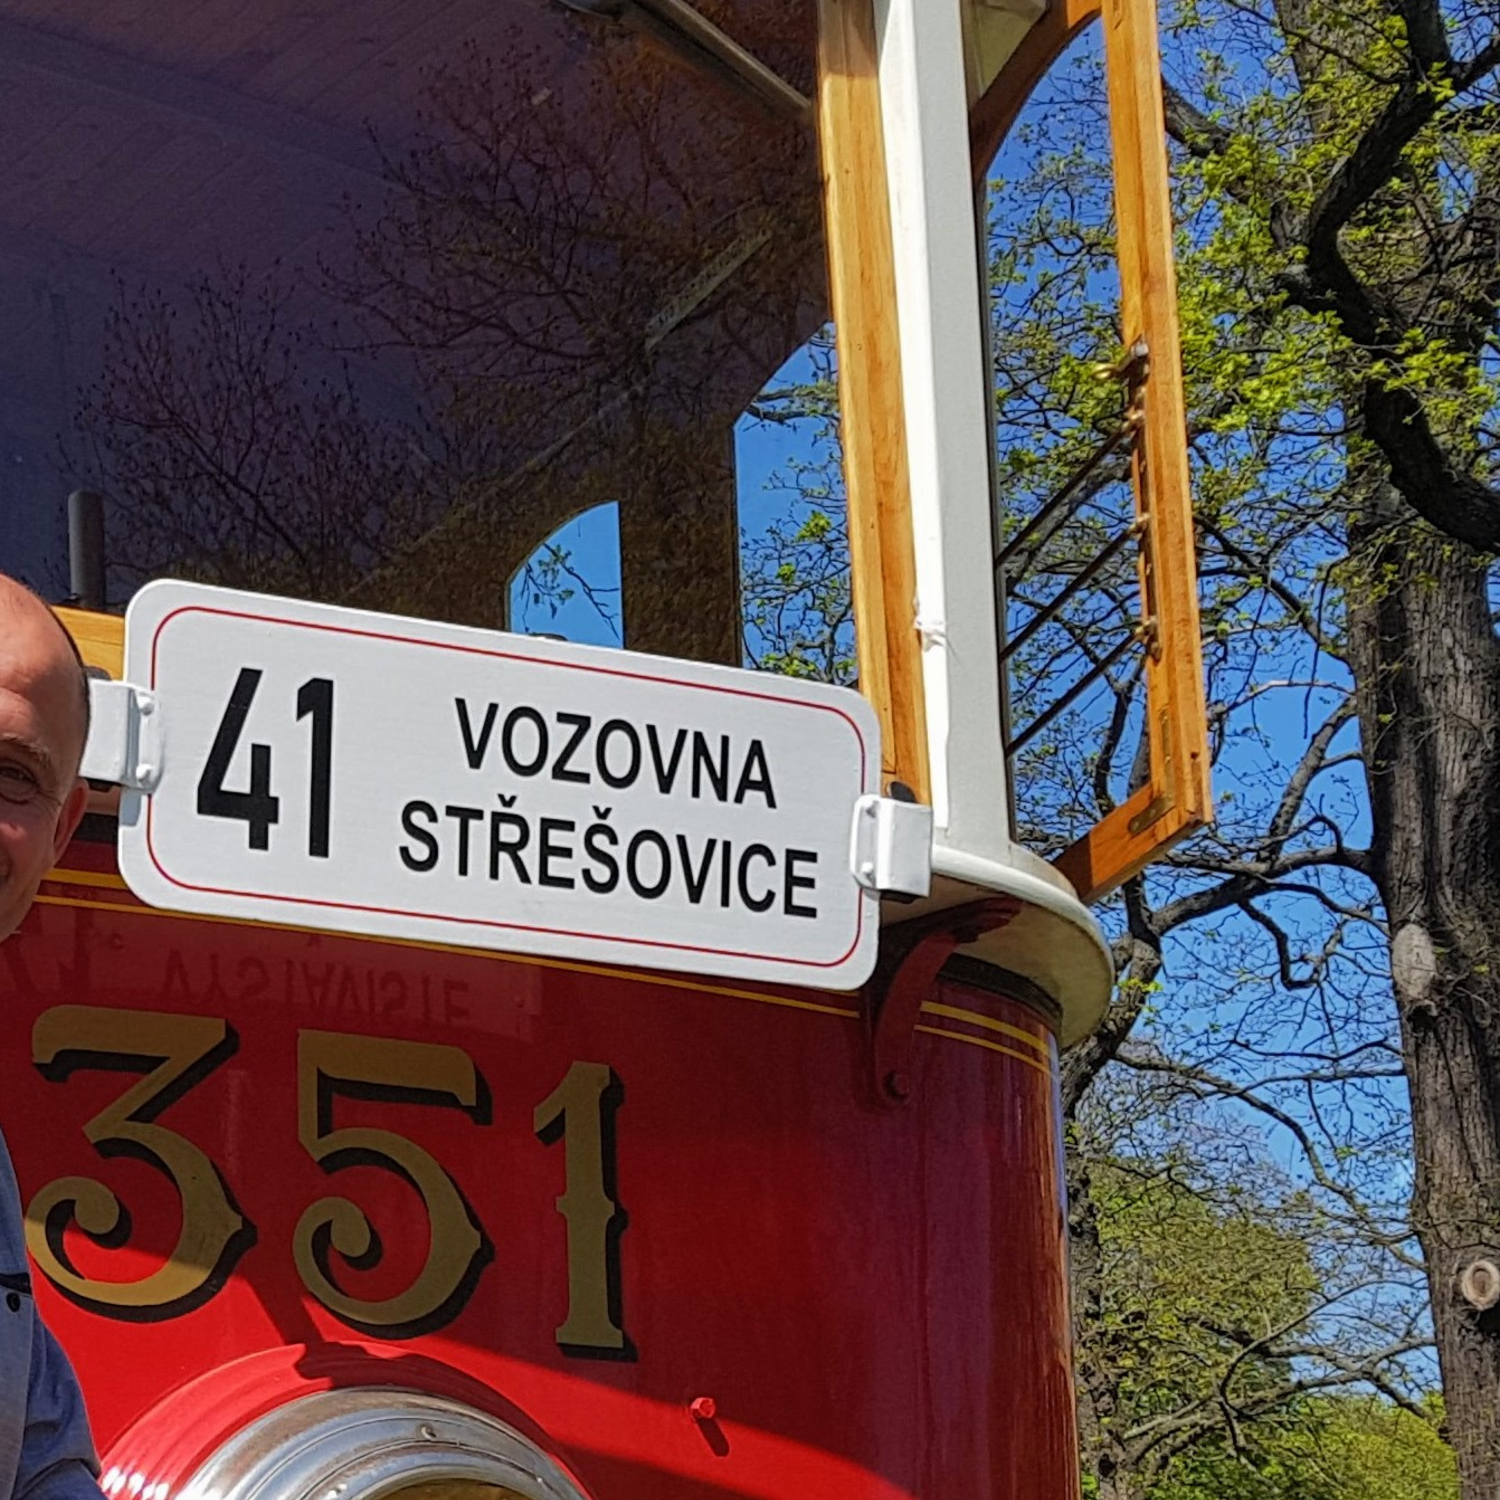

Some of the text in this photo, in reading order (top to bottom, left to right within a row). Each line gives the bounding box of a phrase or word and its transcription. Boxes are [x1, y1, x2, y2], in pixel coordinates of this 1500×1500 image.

[196, 667, 334, 859] 41
[454, 697, 777, 809] VOZOVNA
[399, 793, 818, 919] STŘEŠOVICE
[25, 1004, 638, 1362] 351
